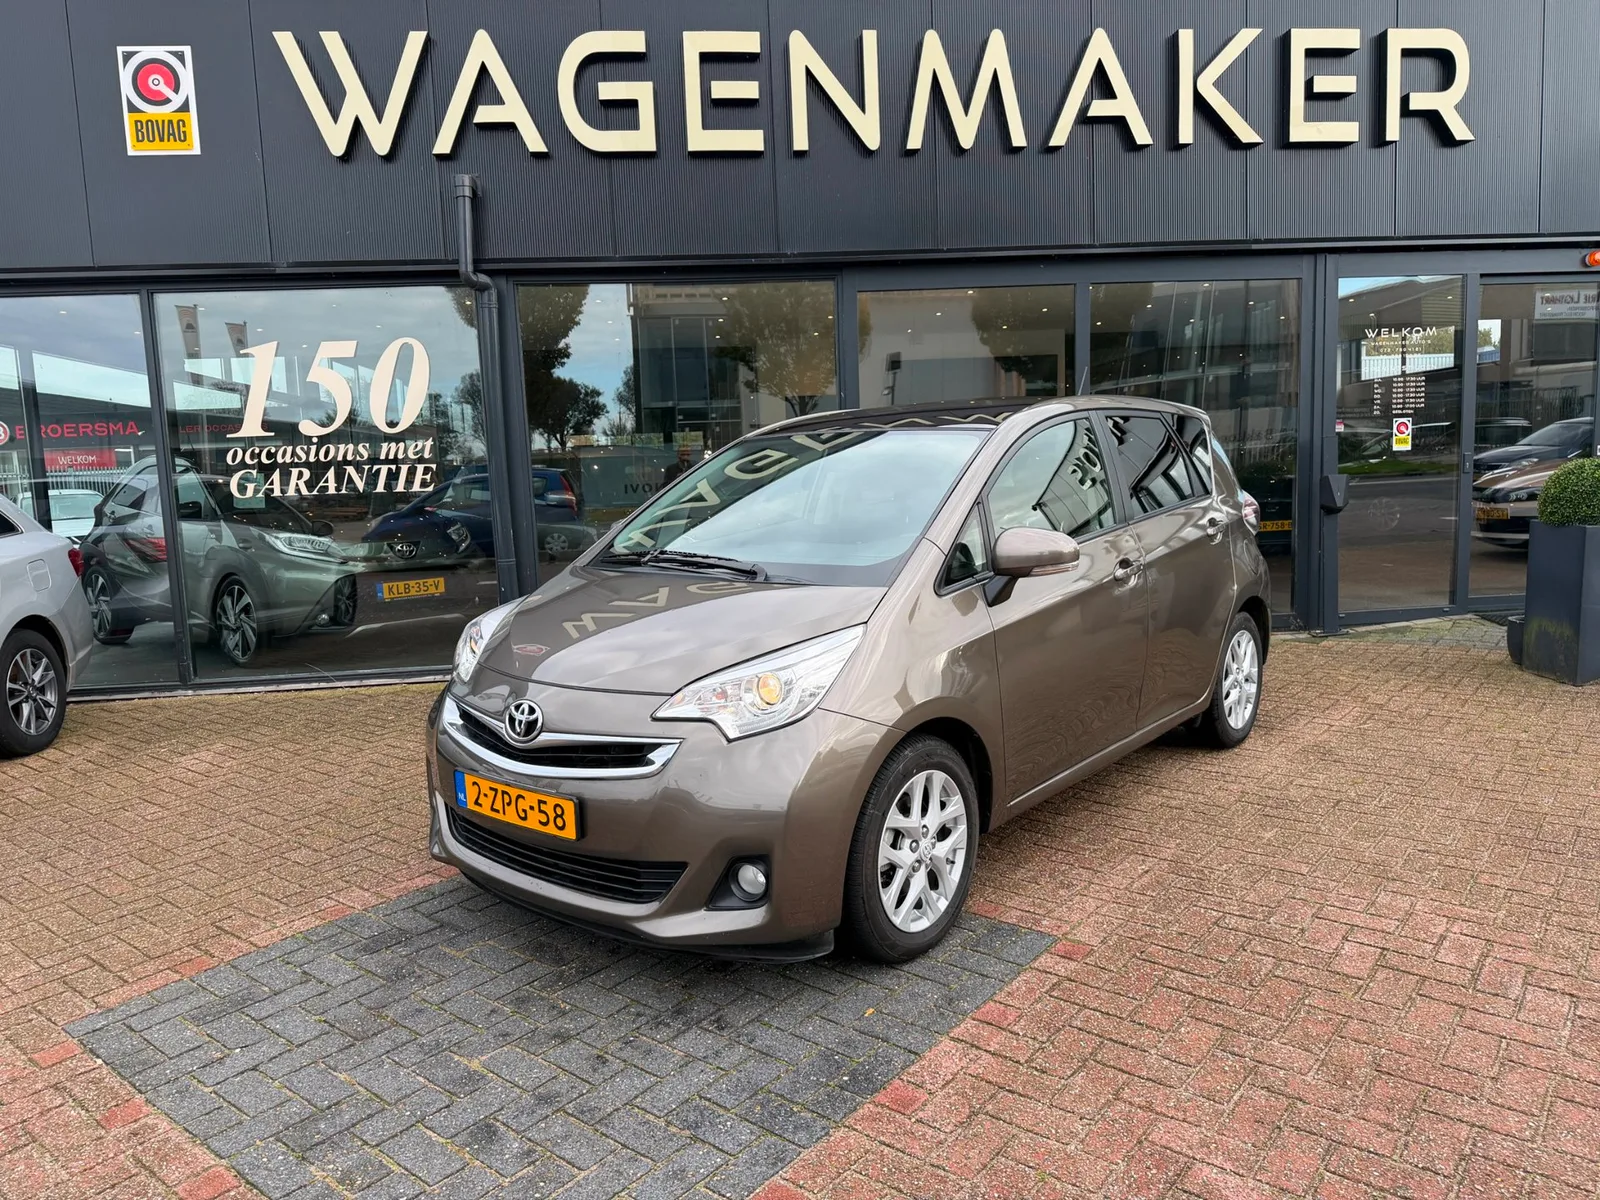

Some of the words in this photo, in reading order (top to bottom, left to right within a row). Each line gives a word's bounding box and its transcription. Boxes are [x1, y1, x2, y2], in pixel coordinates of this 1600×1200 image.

[272, 28, 1476, 157] WAGENMAKER
[134, 119, 187, 143] BOVAG
[1365, 326, 1437, 339] WELKOM
[226, 337, 430, 438] 150
[58, 455, 97, 465] WELKOM
[226, 436, 370, 466] occasions
[380, 436, 434, 460] met
[229, 463, 437, 499] GARANTIE
[388, 579, 440, 596] KLB-35-V
[471, 781, 566, 831] 2-ZPG-58
